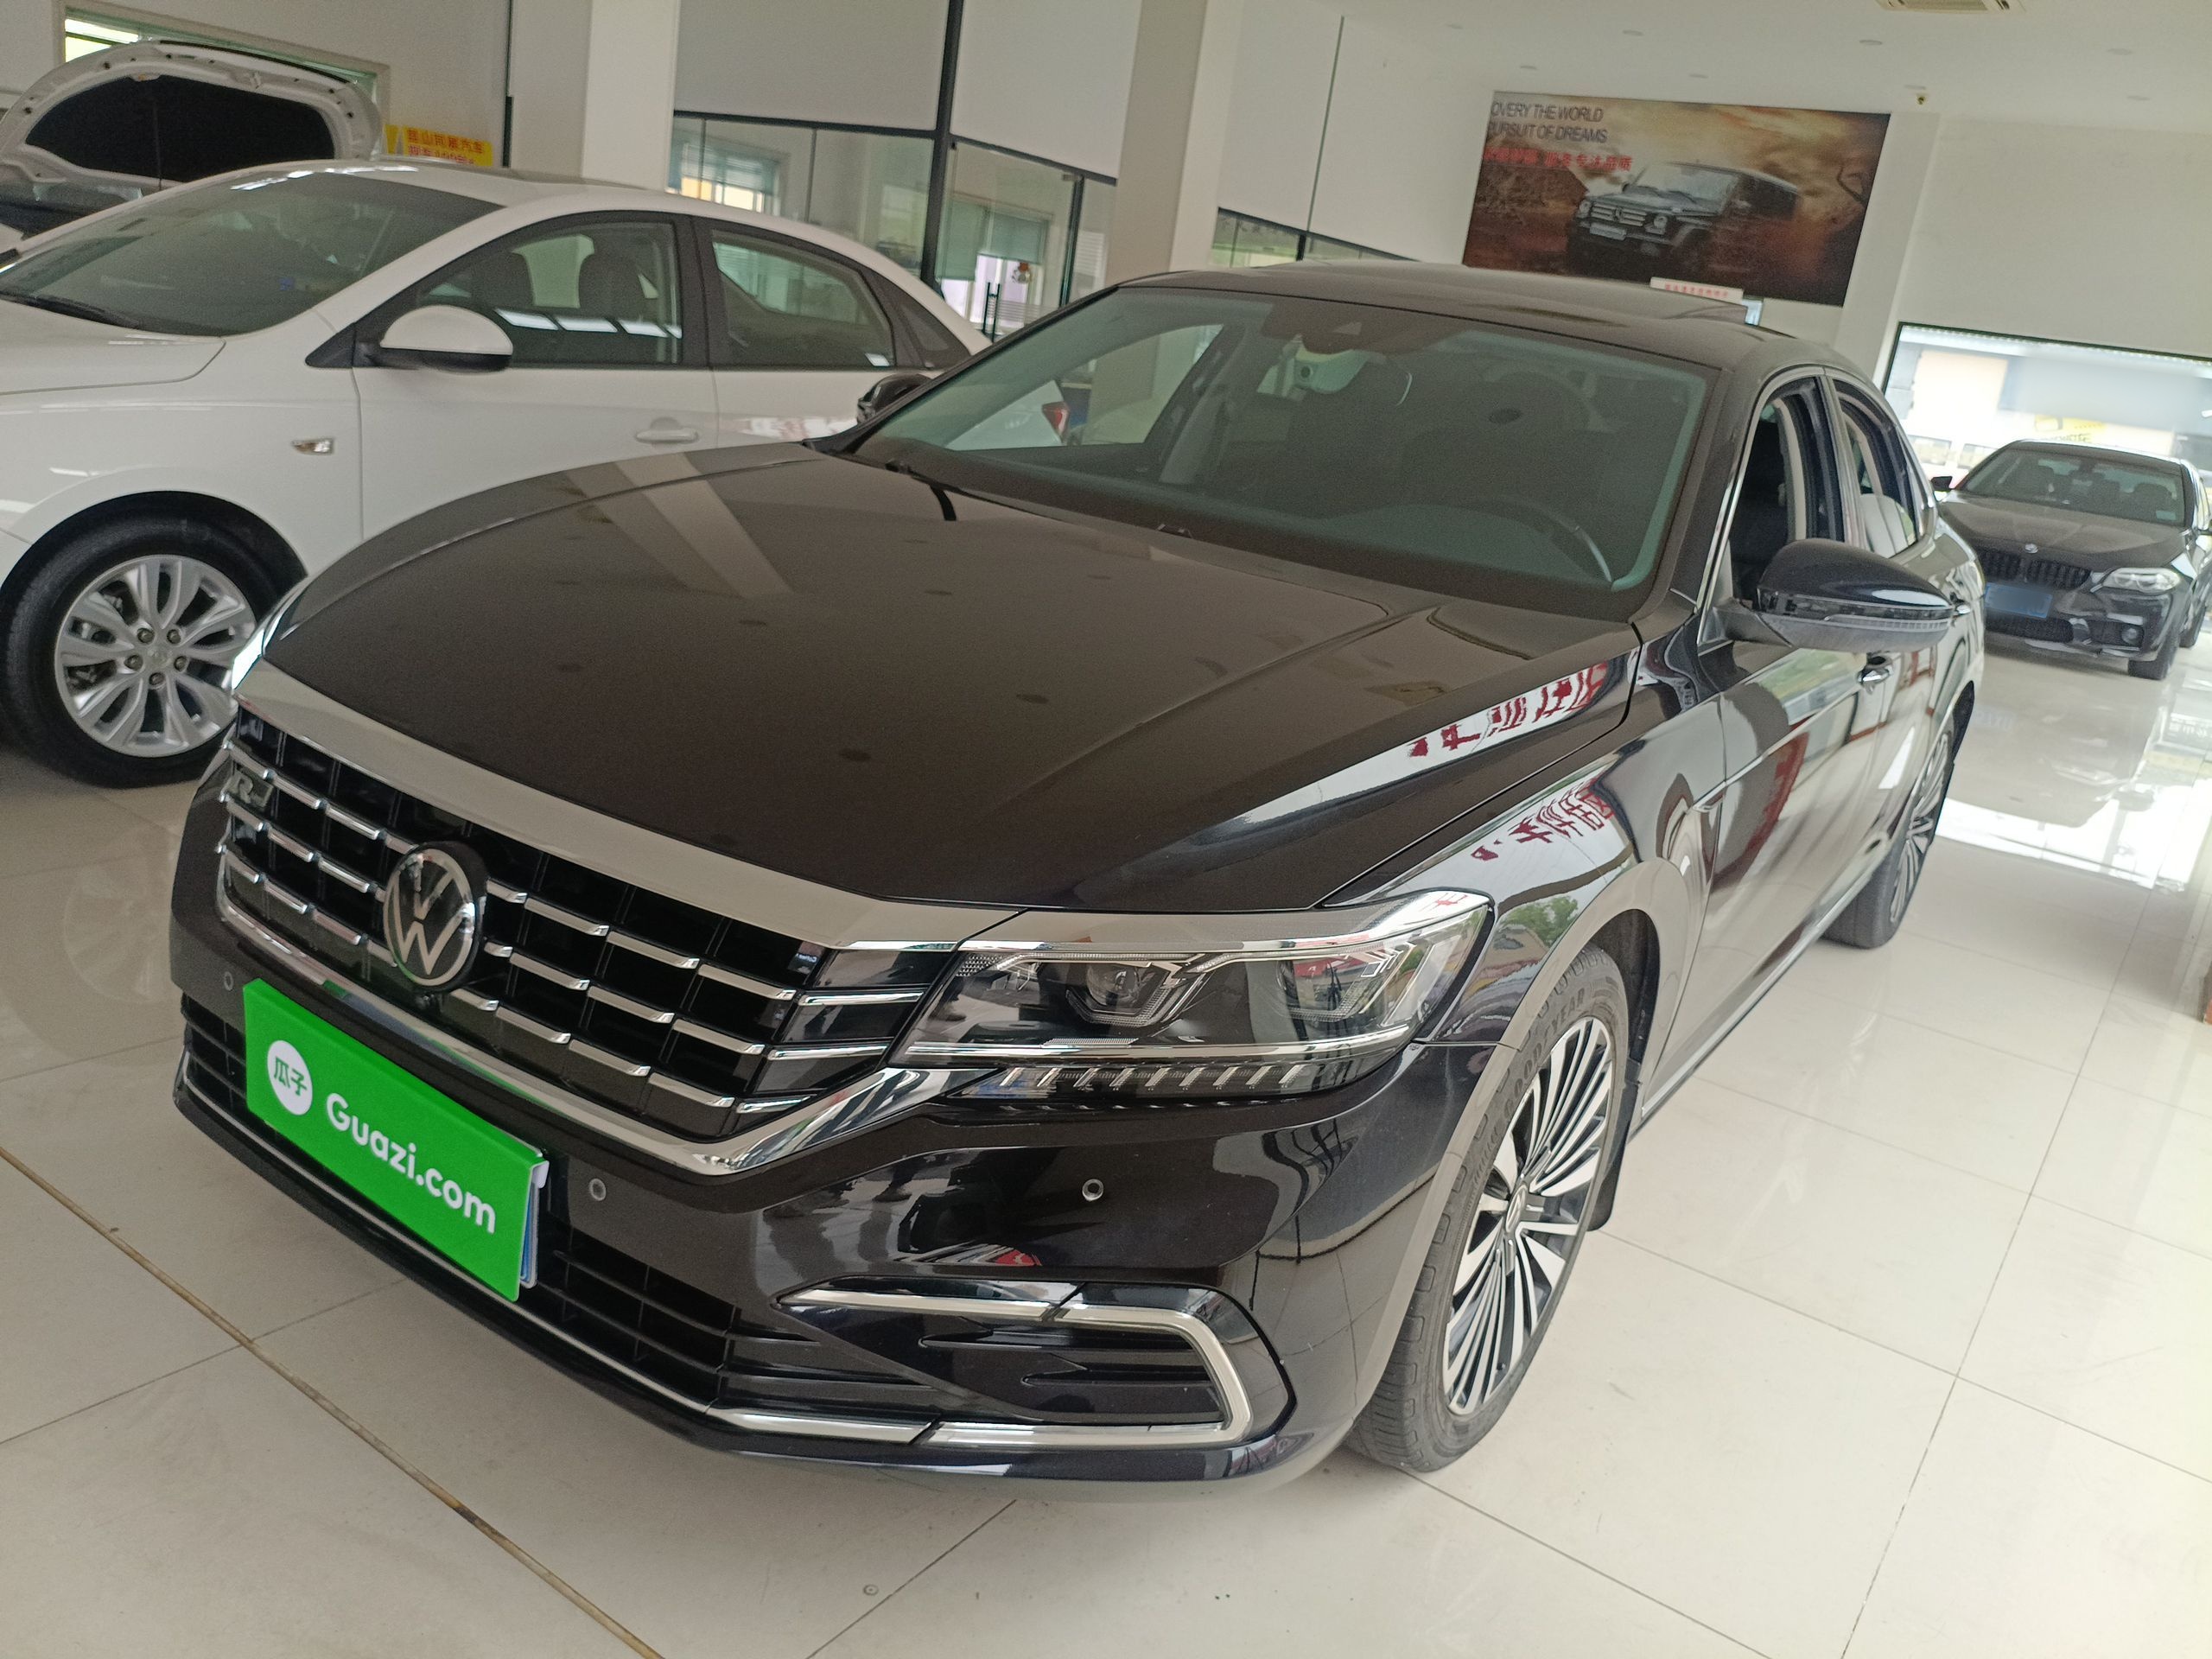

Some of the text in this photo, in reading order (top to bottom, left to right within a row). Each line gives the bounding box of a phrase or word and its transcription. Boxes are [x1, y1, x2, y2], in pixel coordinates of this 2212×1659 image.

[1534, 104, 1556, 120] THE
[1559, 106, 1605, 123] WORLD
[1537, 124, 1556, 140] OF
[1556, 126, 1609, 143] DREAMS
[273, 1056, 308, 1096] 瓜子
[325, 1092, 497, 1235] Guazi.com
